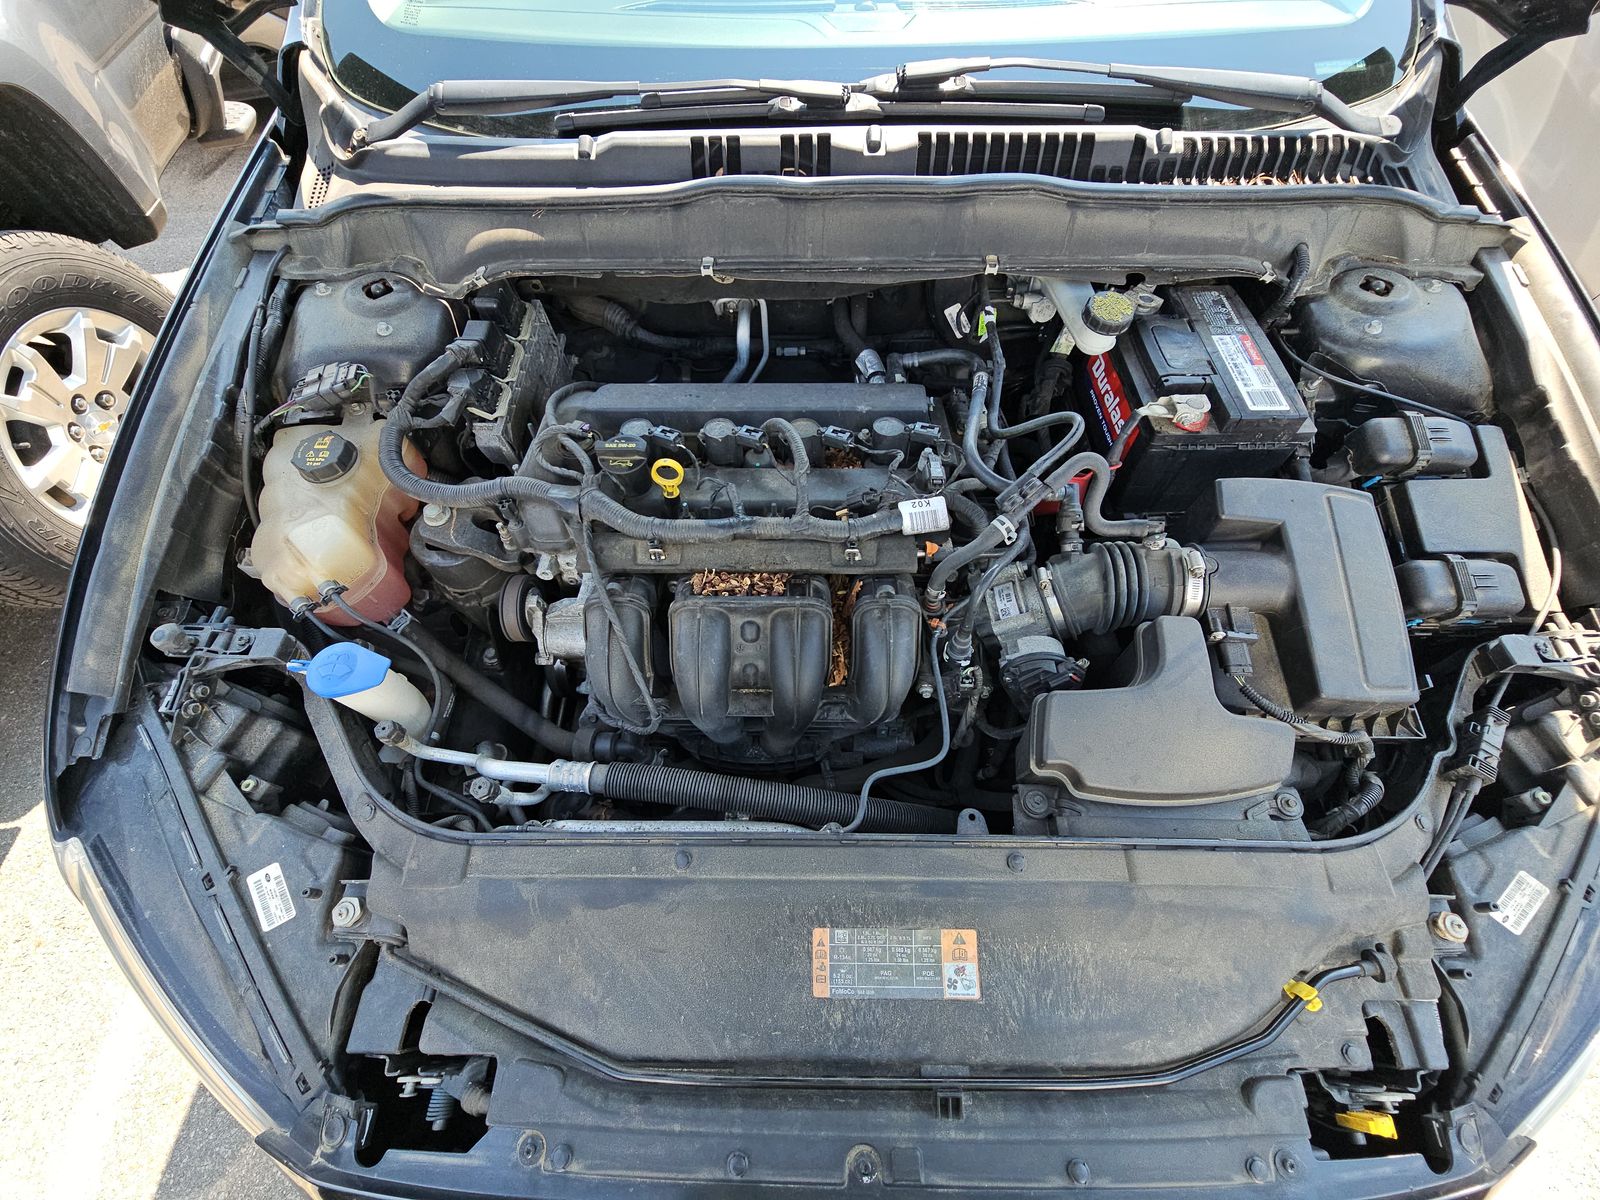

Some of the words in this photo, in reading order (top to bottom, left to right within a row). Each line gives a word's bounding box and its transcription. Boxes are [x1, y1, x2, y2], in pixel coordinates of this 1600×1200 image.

[1089, 388, 1103, 420] PROVEN
[1101, 420, 1114, 447] TOUGH
[1091, 353, 1125, 435] Duralas
[911, 499, 931, 509] K02
